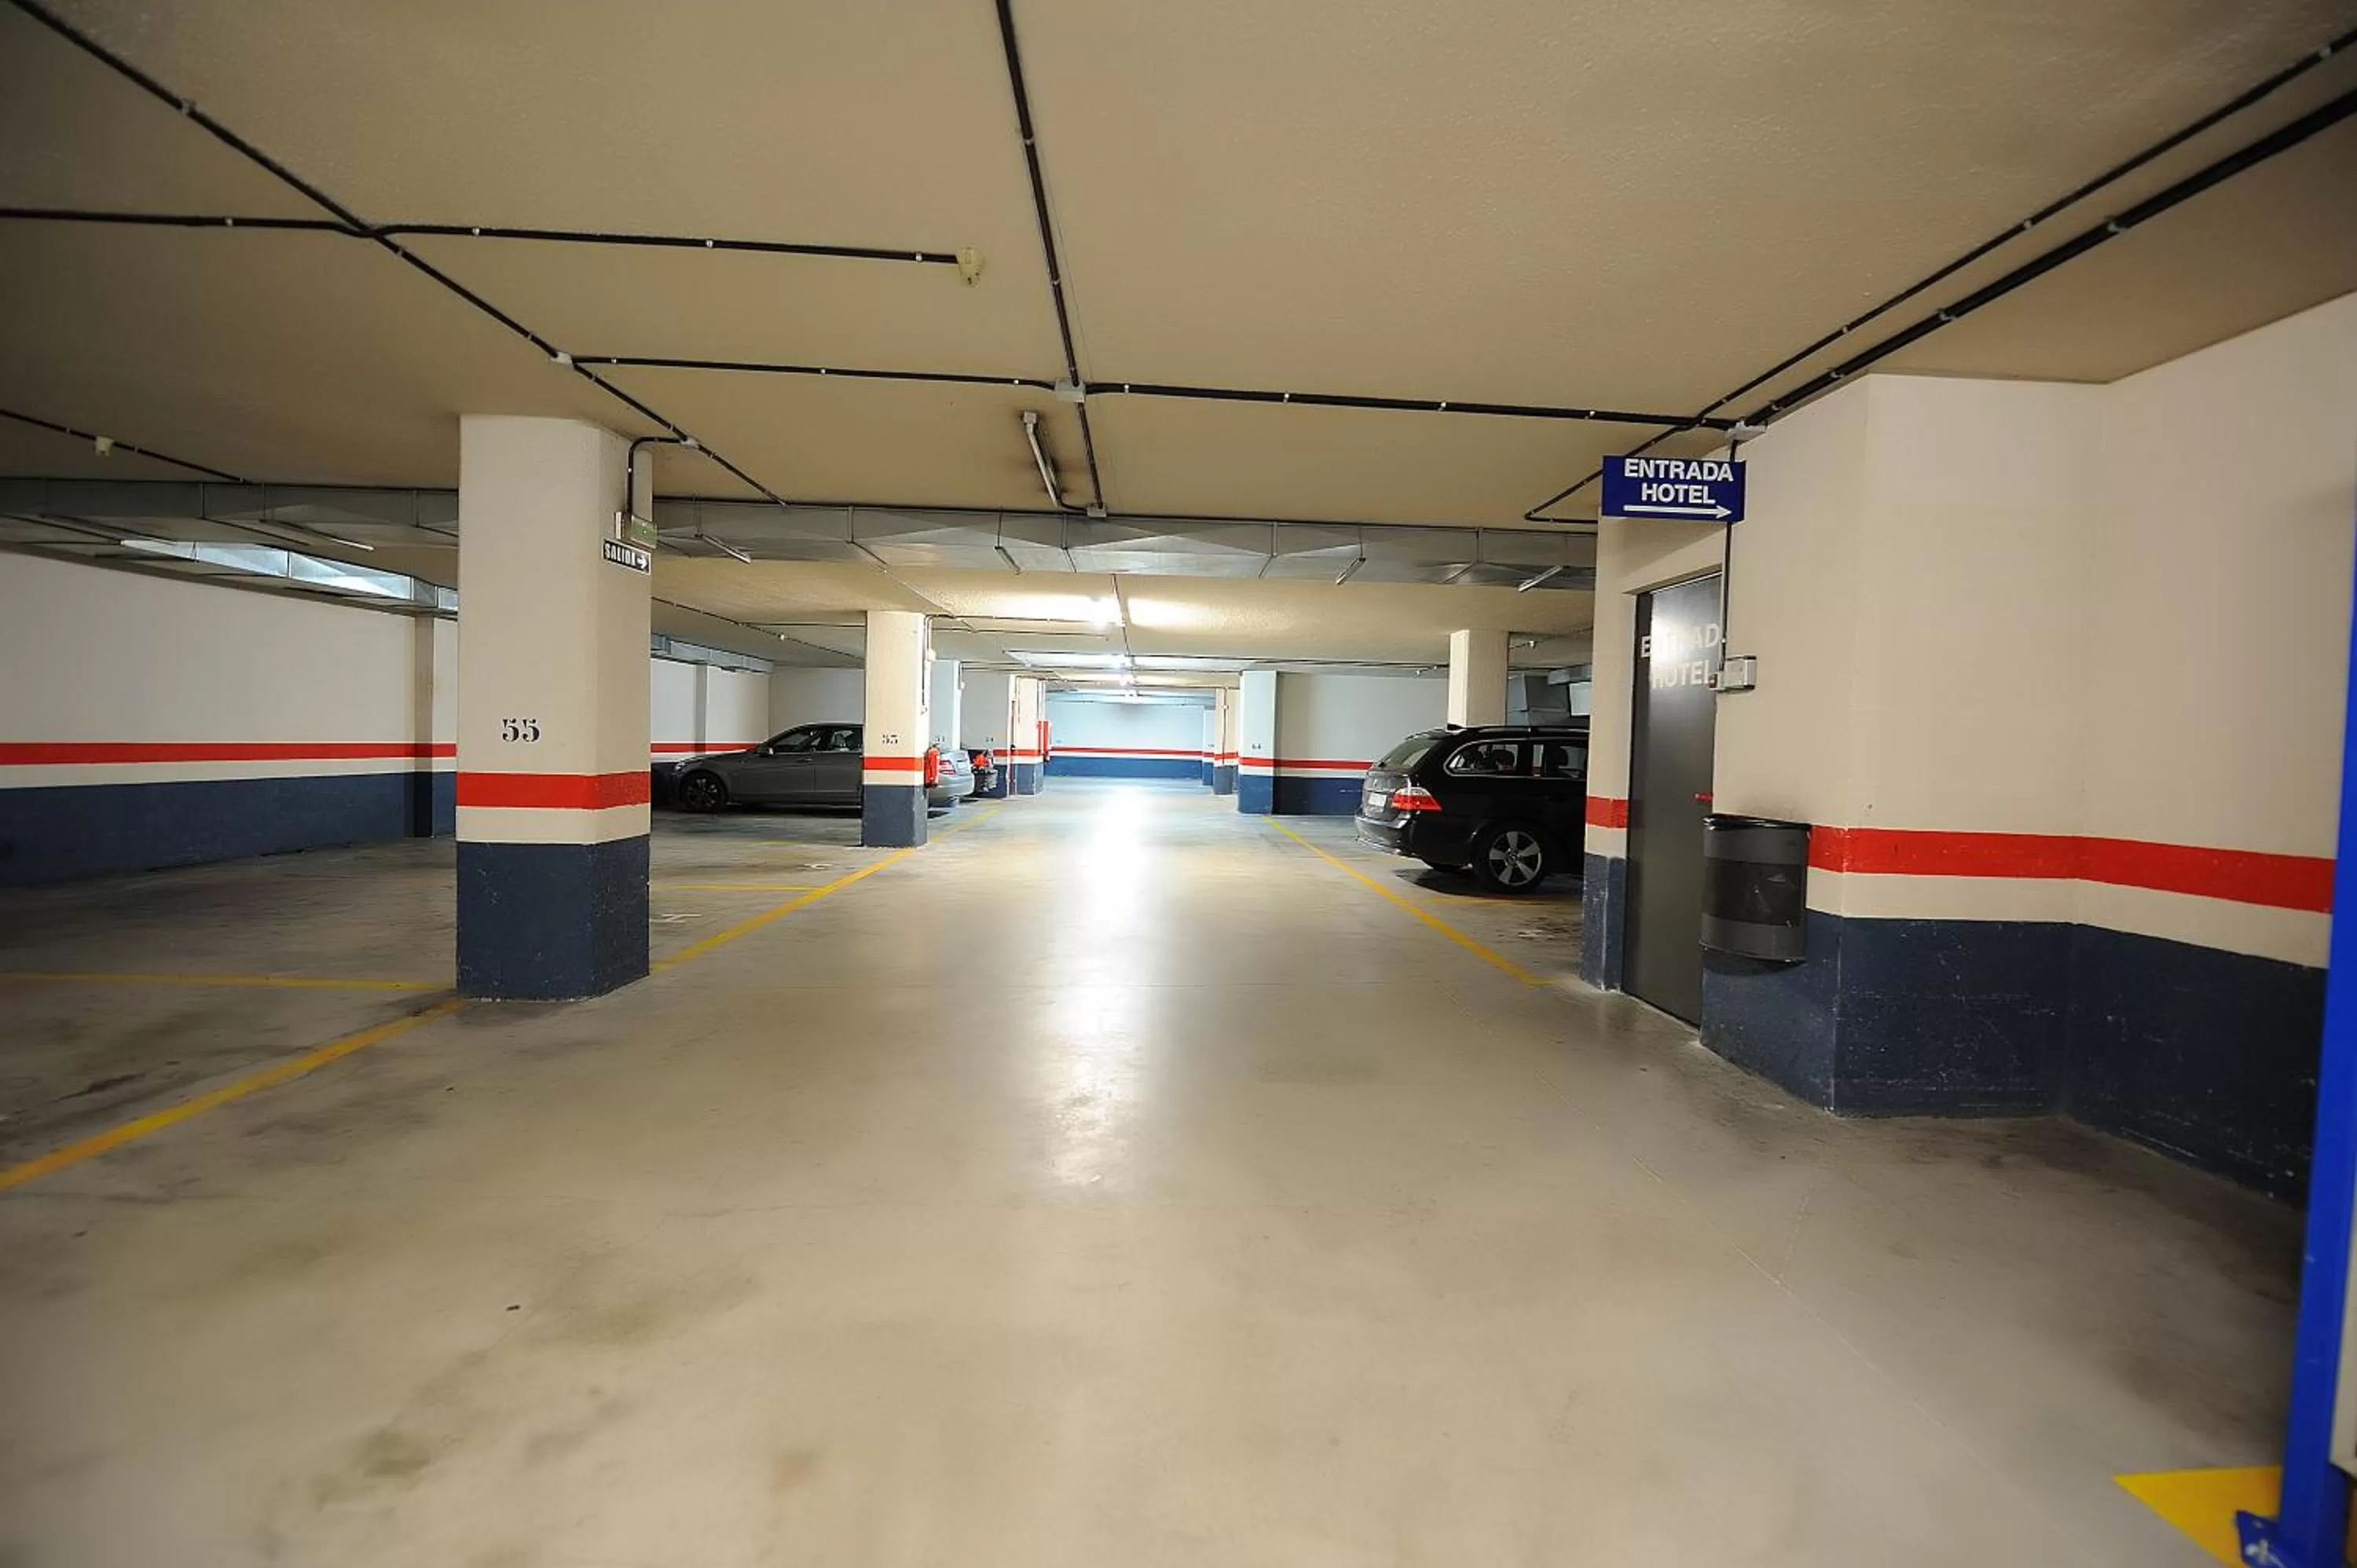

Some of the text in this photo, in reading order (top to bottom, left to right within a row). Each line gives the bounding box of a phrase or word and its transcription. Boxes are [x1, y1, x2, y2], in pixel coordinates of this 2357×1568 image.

[1623, 458, 1734, 482] ENTRADA
[1640, 482, 1716, 504] HOTEL
[502, 718, 541, 742] 55
